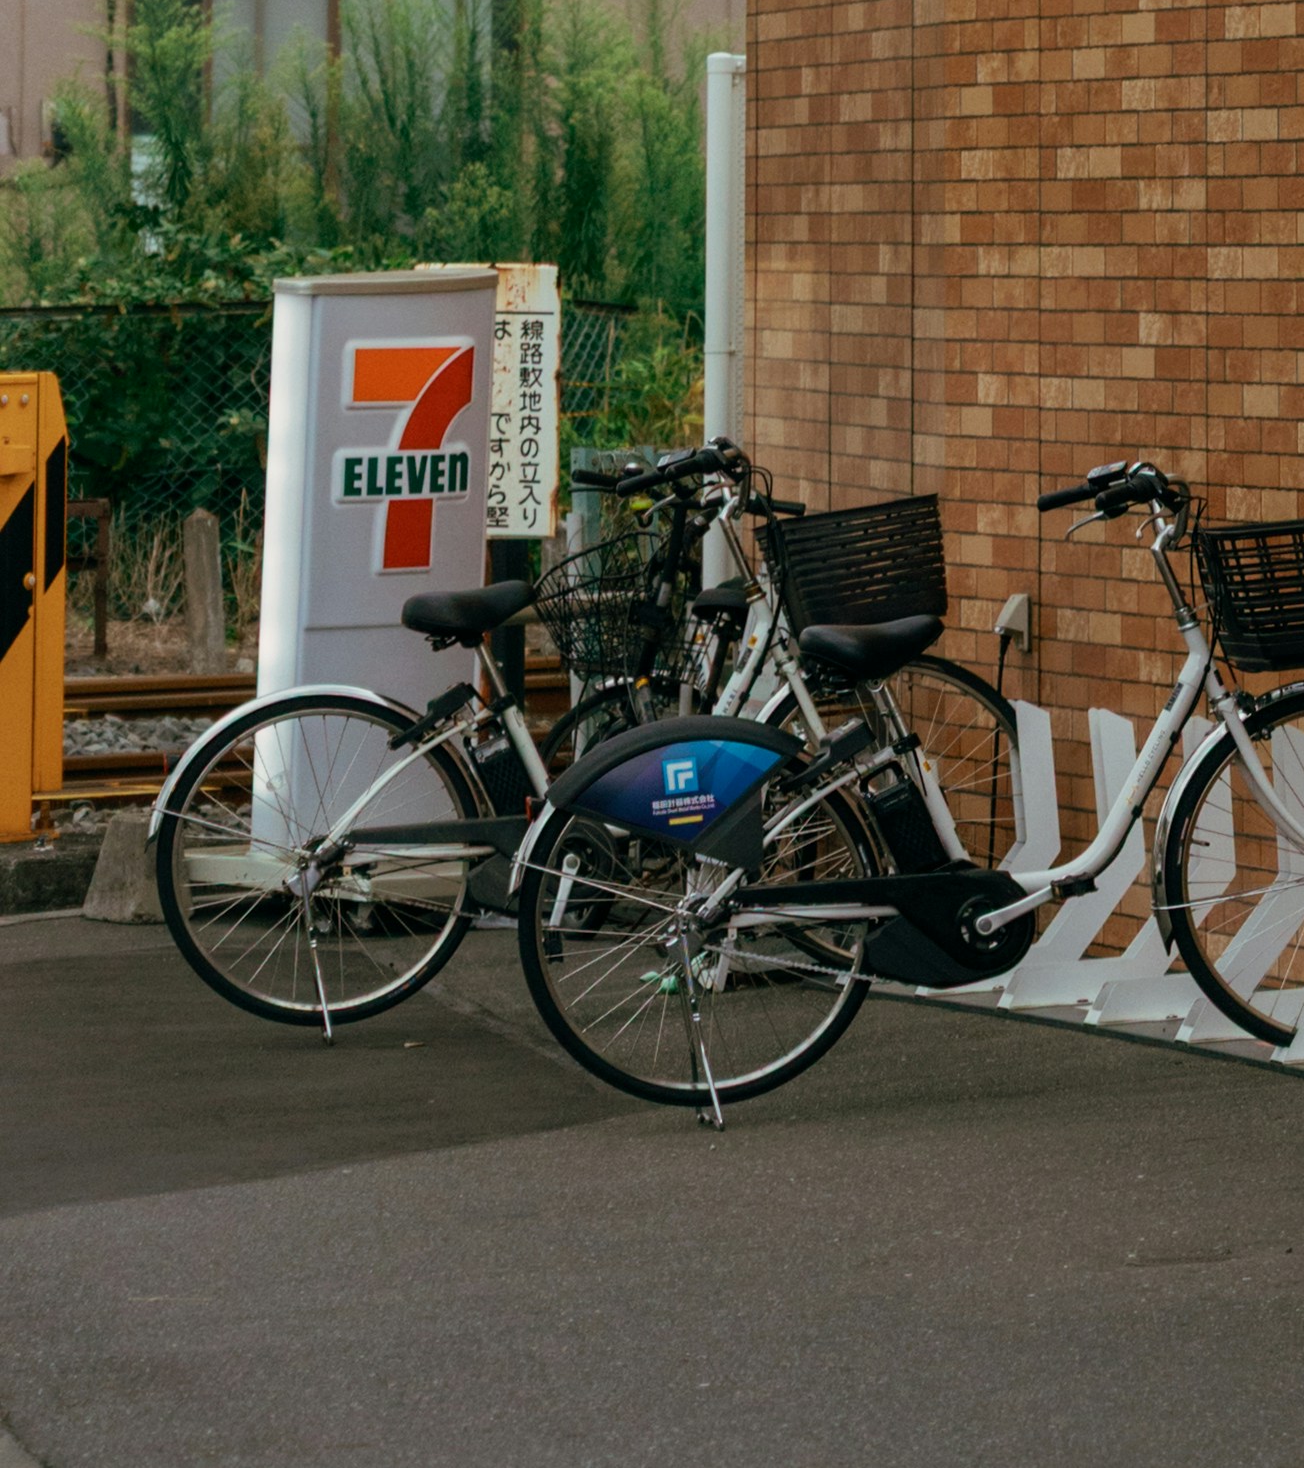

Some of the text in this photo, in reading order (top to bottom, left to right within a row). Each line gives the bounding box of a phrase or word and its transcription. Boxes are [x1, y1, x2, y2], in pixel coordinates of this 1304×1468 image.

[518, 319, 545, 528] 線路敷地内の立入り
